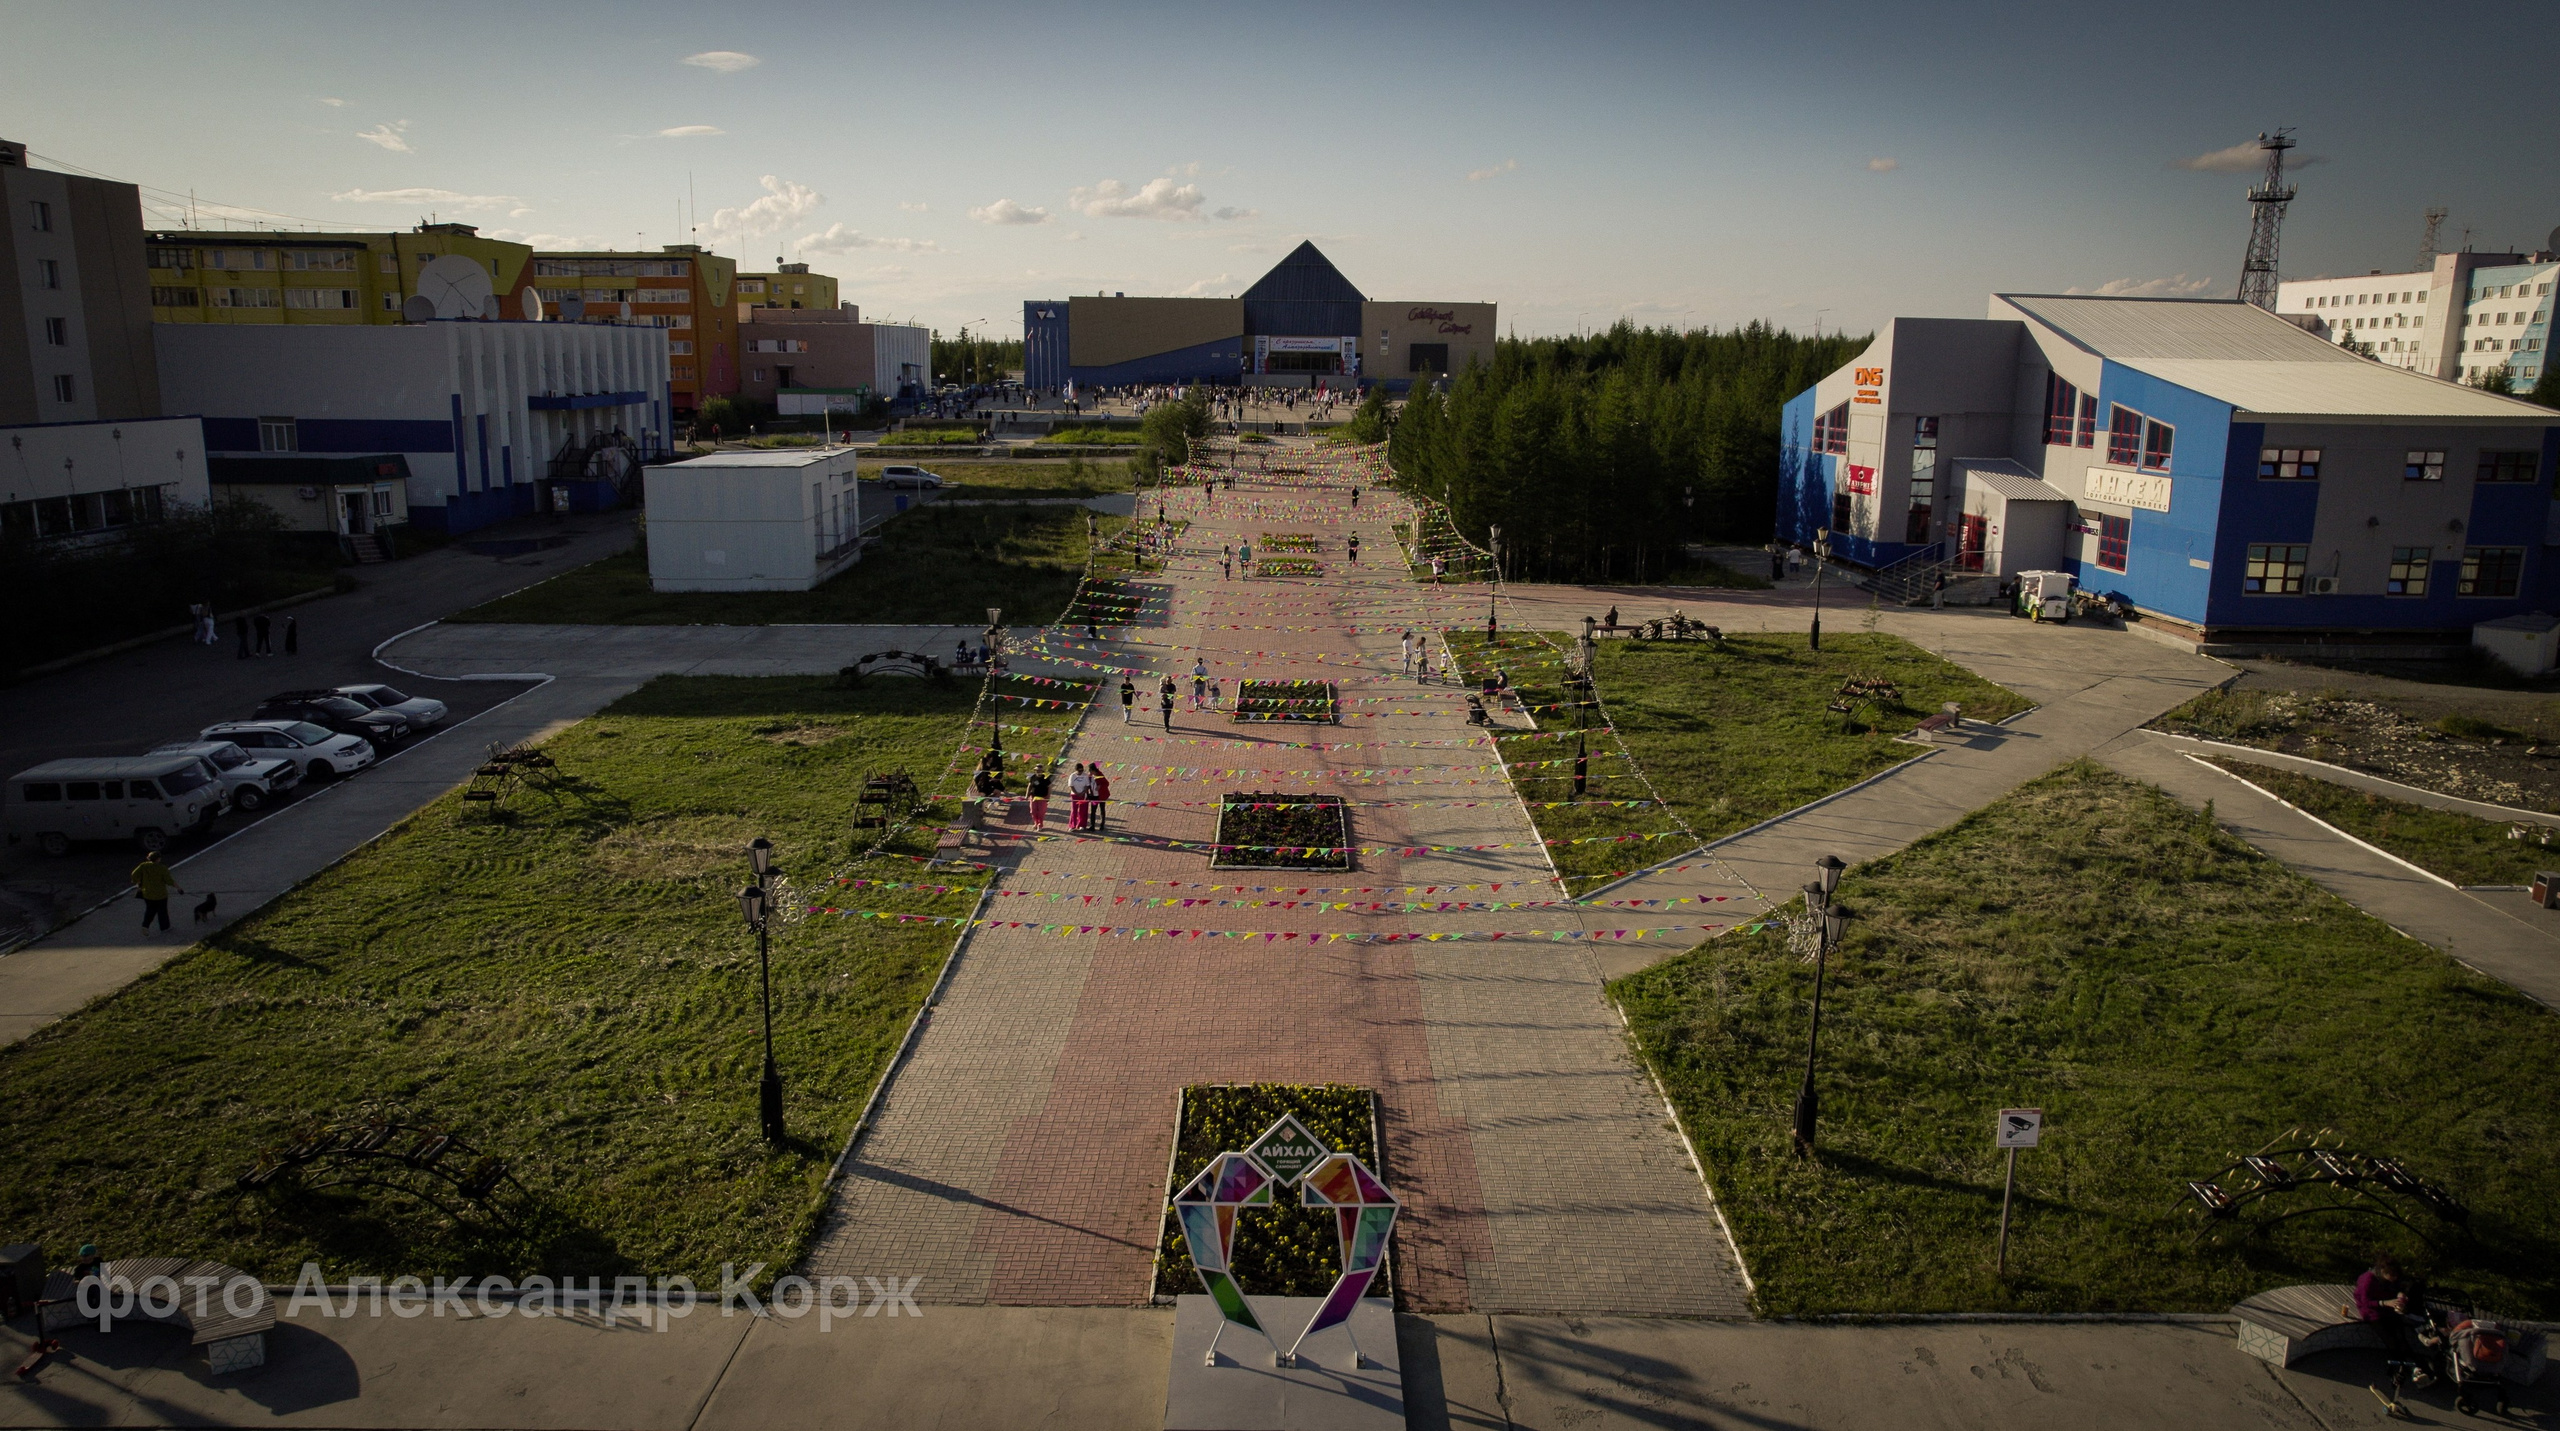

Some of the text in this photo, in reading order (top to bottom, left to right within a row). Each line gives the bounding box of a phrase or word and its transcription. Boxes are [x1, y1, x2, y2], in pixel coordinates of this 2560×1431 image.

[1854, 367, 1883, 386] DNS
[2091, 475, 2164, 502] АНТЕЙ
[2126, 499, 2168, 511] КОМПЛЕКС
[1261, 1143, 1316, 1157] АЙХАЛ
